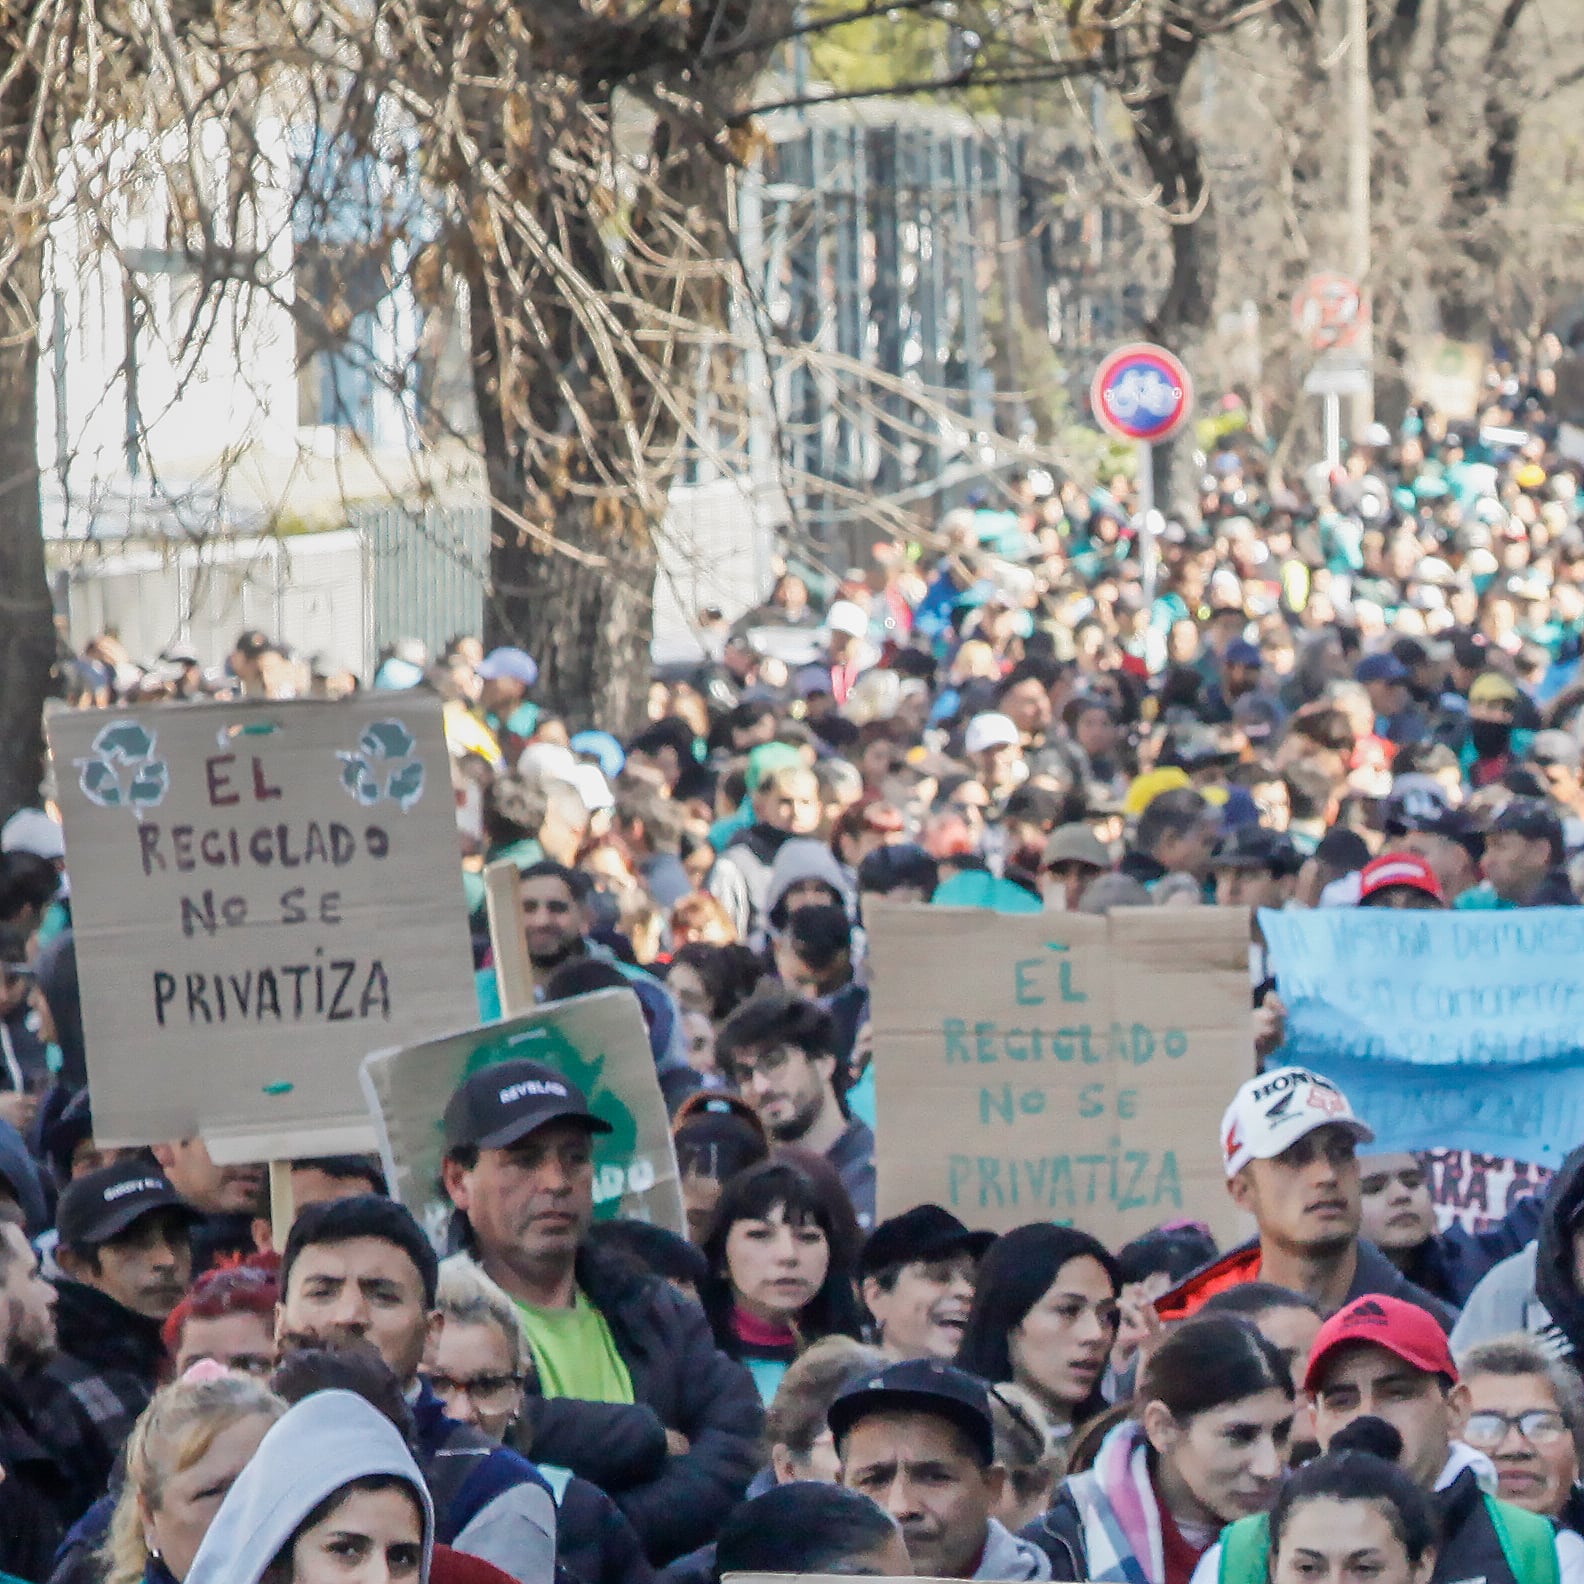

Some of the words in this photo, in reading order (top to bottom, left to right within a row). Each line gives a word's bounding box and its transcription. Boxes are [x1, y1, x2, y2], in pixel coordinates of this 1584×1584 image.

[206, 754, 282, 806] EL
[138, 821, 389, 875] RECICLADO
[180, 889, 248, 938] NO
[280, 887, 343, 924] SE
[1015, 960, 1088, 1006] EL
[943, 1017, 1188, 1066] RECICLADO
[979, 1082, 1046, 1126] NO
[1078, 1083, 1137, 1120] SE
